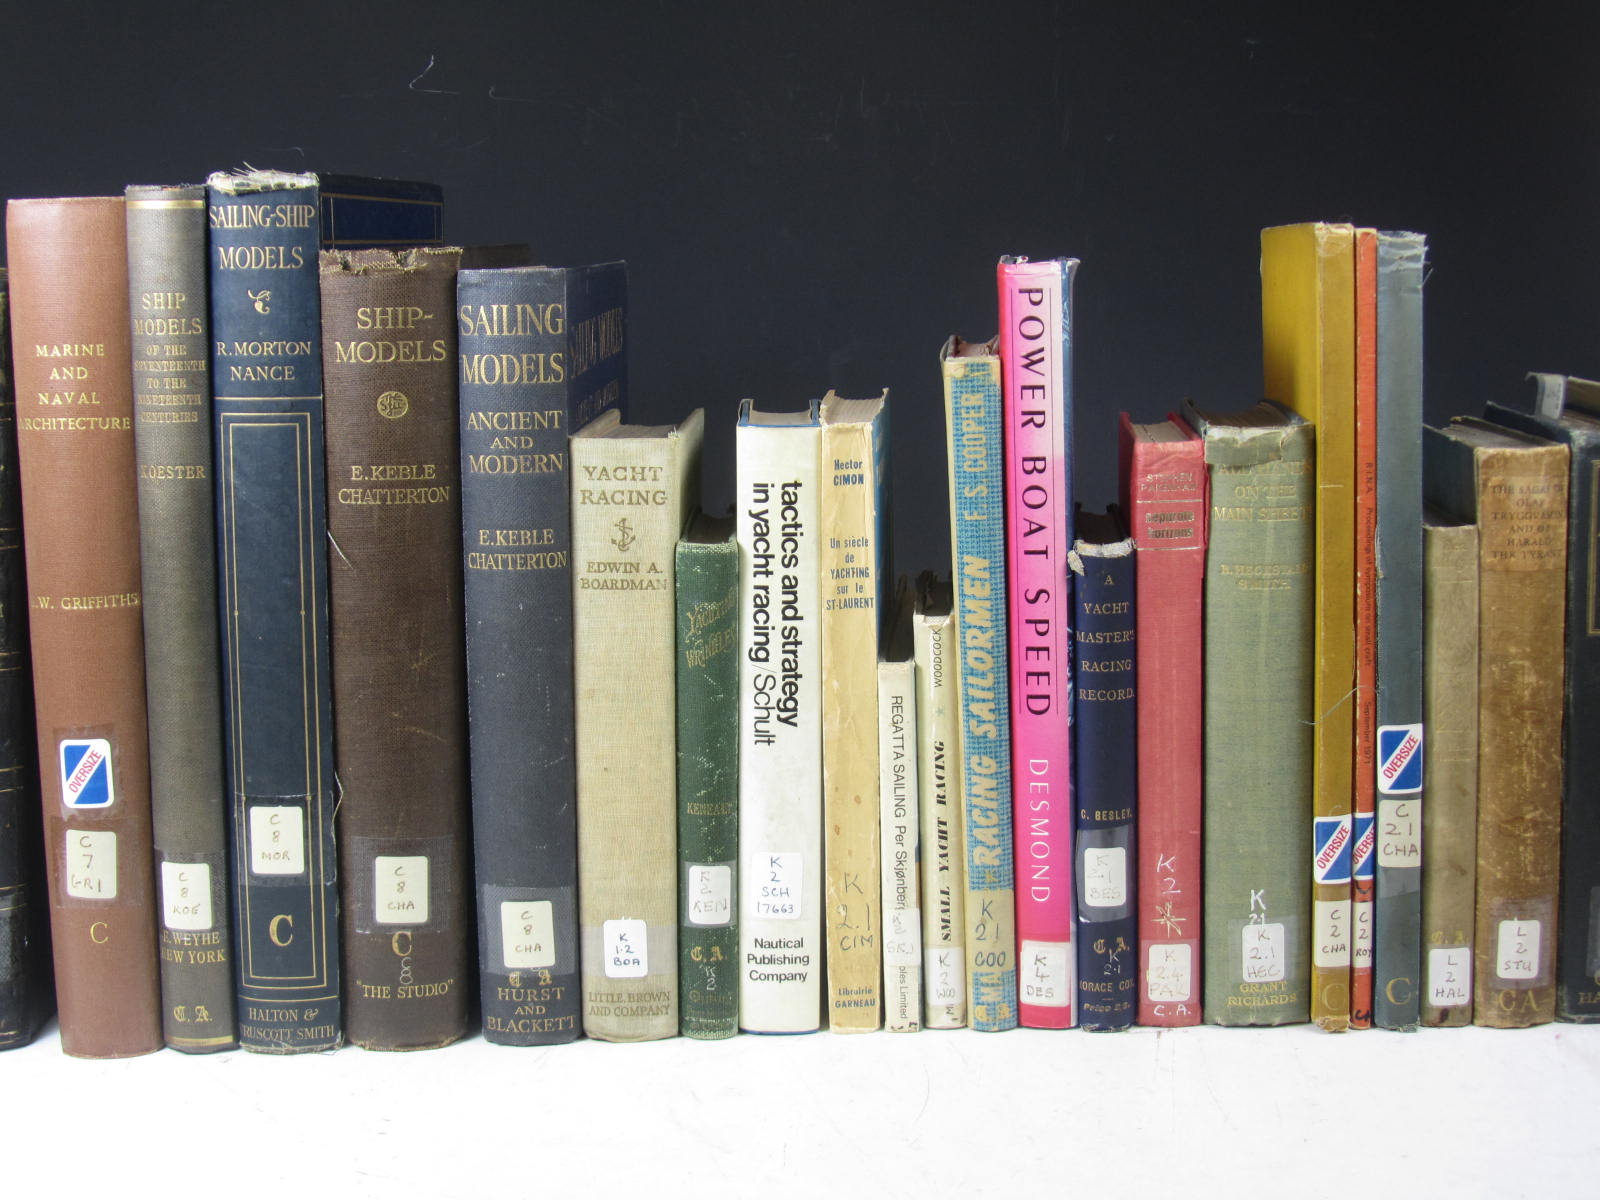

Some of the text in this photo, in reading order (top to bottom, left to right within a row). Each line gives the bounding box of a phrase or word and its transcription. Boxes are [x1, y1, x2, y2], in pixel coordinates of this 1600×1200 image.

[209, 204, 315, 228] SAILING-SHIP
[219, 246, 304, 270] MODELS
[142, 292, 186, 310] SHIP
[134, 318, 202, 335] MODELS
[460, 303, 563, 337] SAILING
[36, 344, 105, 357] MARINE
[146, 345, 187, 356] OF THE
[335, 340, 447, 363] MODELS
[50, 367, 88, 380] AND
[230, 366, 296, 381] NANCE
[462, 353, 564, 385] MODELS
[147, 378, 187, 389] TO THE
[38, 392, 100, 405] NAVAL
[467, 410, 563, 430] ANCIENT
[961, 392, 987, 472] COOPER
[490, 436, 534, 449] AND
[468, 453, 563, 474] MODERN
[834, 459, 863, 470] Hector
[140, 465, 206, 480] KOESTER
[583, 465, 663, 482] YACHT
[833, 474, 864, 486] CIMON
[338, 486, 450, 505] CHATTERTON
[580, 489, 667, 506] RACING
[1018, 288, 1051, 716] POWER BOAT SPEED
[830, 535, 869, 548] Un siècle
[468, 551, 567, 571] CHATTERTON
[845, 552, 855, 564] de
[586, 561, 663, 574] EDWIN A.
[831, 566, 870, 579] YACHTING
[1103, 575, 1114, 586] A
[837, 582, 864, 595] sur le
[61, 593, 139, 610] GRIFFITHS
[776, 480, 804, 727] tactics and strategy
[826, 597, 874, 611] ST-LAURENT
[1083, 602, 1130, 614] YACHT
[748, 482, 776, 746] in yacht racing Schult
[933, 628, 943, 688] WOODCOCK
[1081, 659, 1132, 672] RACING
[963, 554, 1001, 866] RACING SAILORMEN
[1382, 734, 1419, 780] OVERSIZE
[68, 749, 103, 793] OVERSIZE
[891, 695, 907, 848] REGATTA SAILING Per
[1395, 803, 1409, 818] C
[1028, 758, 1052, 902] DESMOND
[80, 835, 91, 848] C
[933, 740, 951, 942] SMALL YACHT RACING
[1316, 824, 1351, 870] OVERSIZE
[82, 854, 94, 869] 7
[770, 856, 783, 868] K
[1156, 853, 1175, 872] K
[843, 872, 863, 894] K
[1250, 889, 1266, 911] K
[981, 899, 993, 921] K
[1330, 908, 1340, 920] C
[89, 922, 109, 944] C
[268, 914, 293, 947] C
[391, 931, 412, 957] C
[754, 937, 804, 949] Nautical
[188, 949, 226, 964] YORK
[747, 953, 810, 967] Publishing
[749, 970, 808, 983] Company
[497, 987, 565, 1001] HURST
[838, 987, 873, 997] Librairie
[1240, 981, 1287, 994] GRANT
[1386, 977, 1412, 1005] C
[627, 991, 670, 1002] BROWN
[835, 998, 875, 1009] GARNEAU
[1226, 993, 1297, 1007] RICHARDS
[1322, 983, 1347, 1011] C
[249, 1007, 319, 1022] HALTON &
[514, 1005, 546, 1015] AND
[588, 1004, 670, 1016] AND COMPANY
[487, 1015, 575, 1033] BLACKETT
[296, 1025, 335, 1040] SMITH
